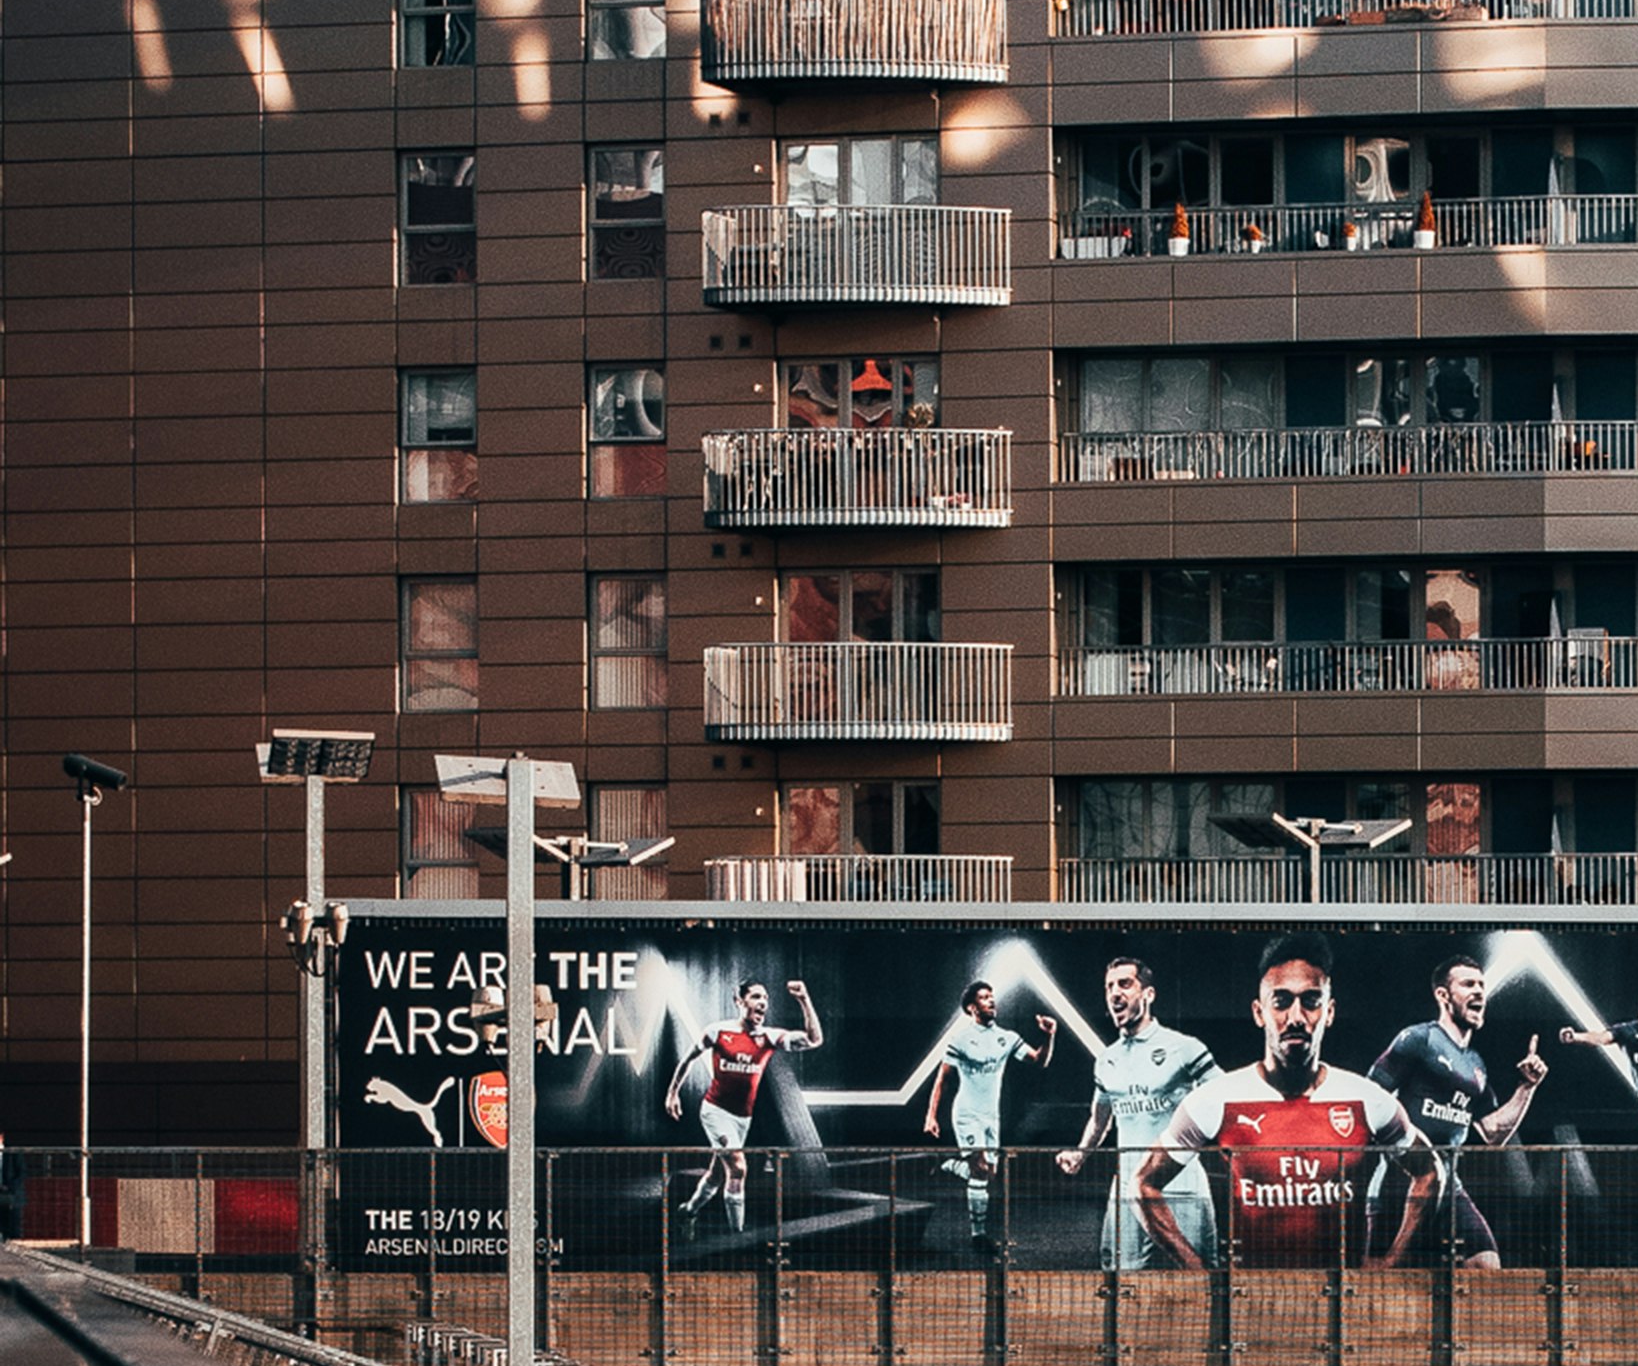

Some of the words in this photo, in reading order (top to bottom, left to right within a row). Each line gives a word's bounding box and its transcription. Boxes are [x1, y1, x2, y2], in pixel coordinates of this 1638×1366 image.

[364, 951, 434, 989] WE
[447, 951, 537, 989] AR
[549, 951, 638, 989] THE
[1279, 1155, 1321, 1180] Fly
[1239, 1177, 1354, 1207] Emirates
[365, 1210, 413, 1230] THE
[420, 1208, 481, 1232] 18/19
[487, 1210, 539, 1230] KI
[365, 1237, 564, 1255] ARSENALDIRECOM
